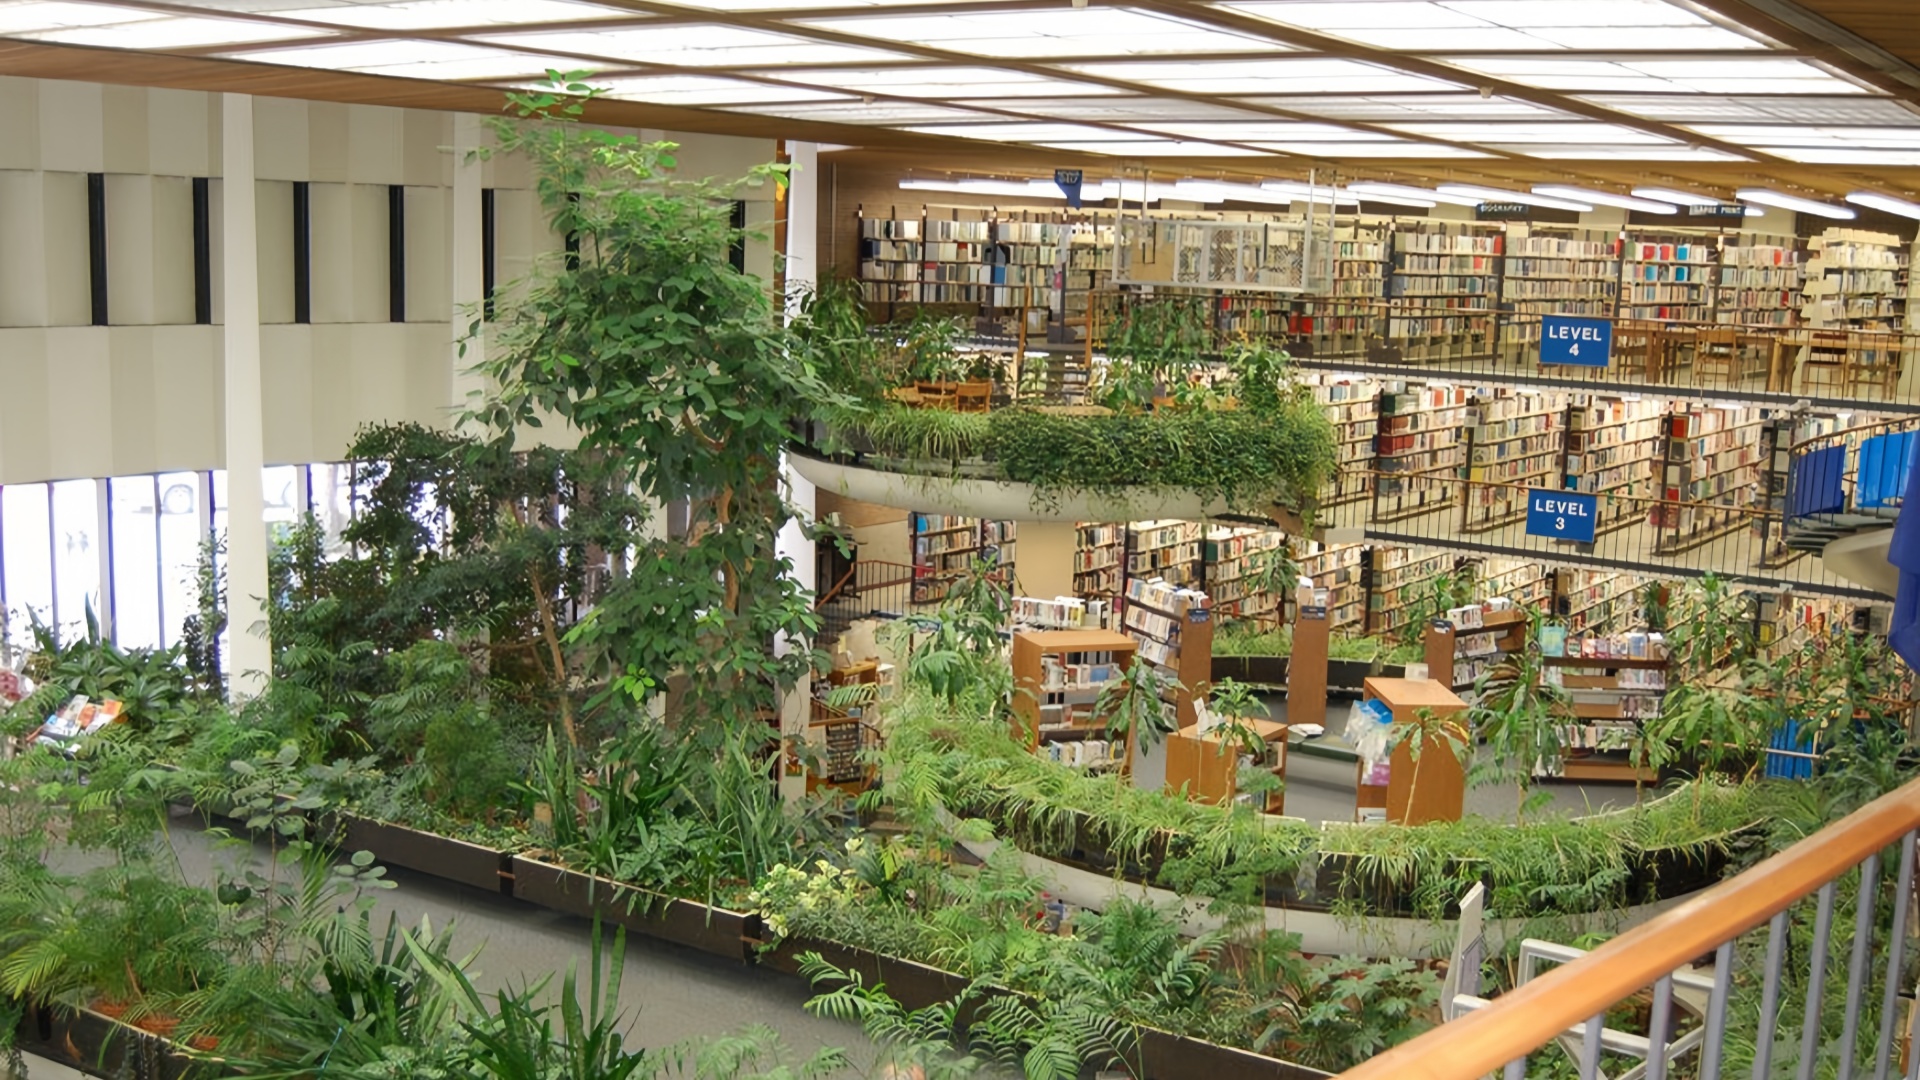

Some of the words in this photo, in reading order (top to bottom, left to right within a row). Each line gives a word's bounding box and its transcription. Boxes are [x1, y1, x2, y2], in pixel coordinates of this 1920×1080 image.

[1549, 325, 1602, 341] LEVEL
[1569, 343, 1579, 356] 4
[1535, 499, 1588, 516] LEVEL
[1555, 517, 1565, 530] 3
